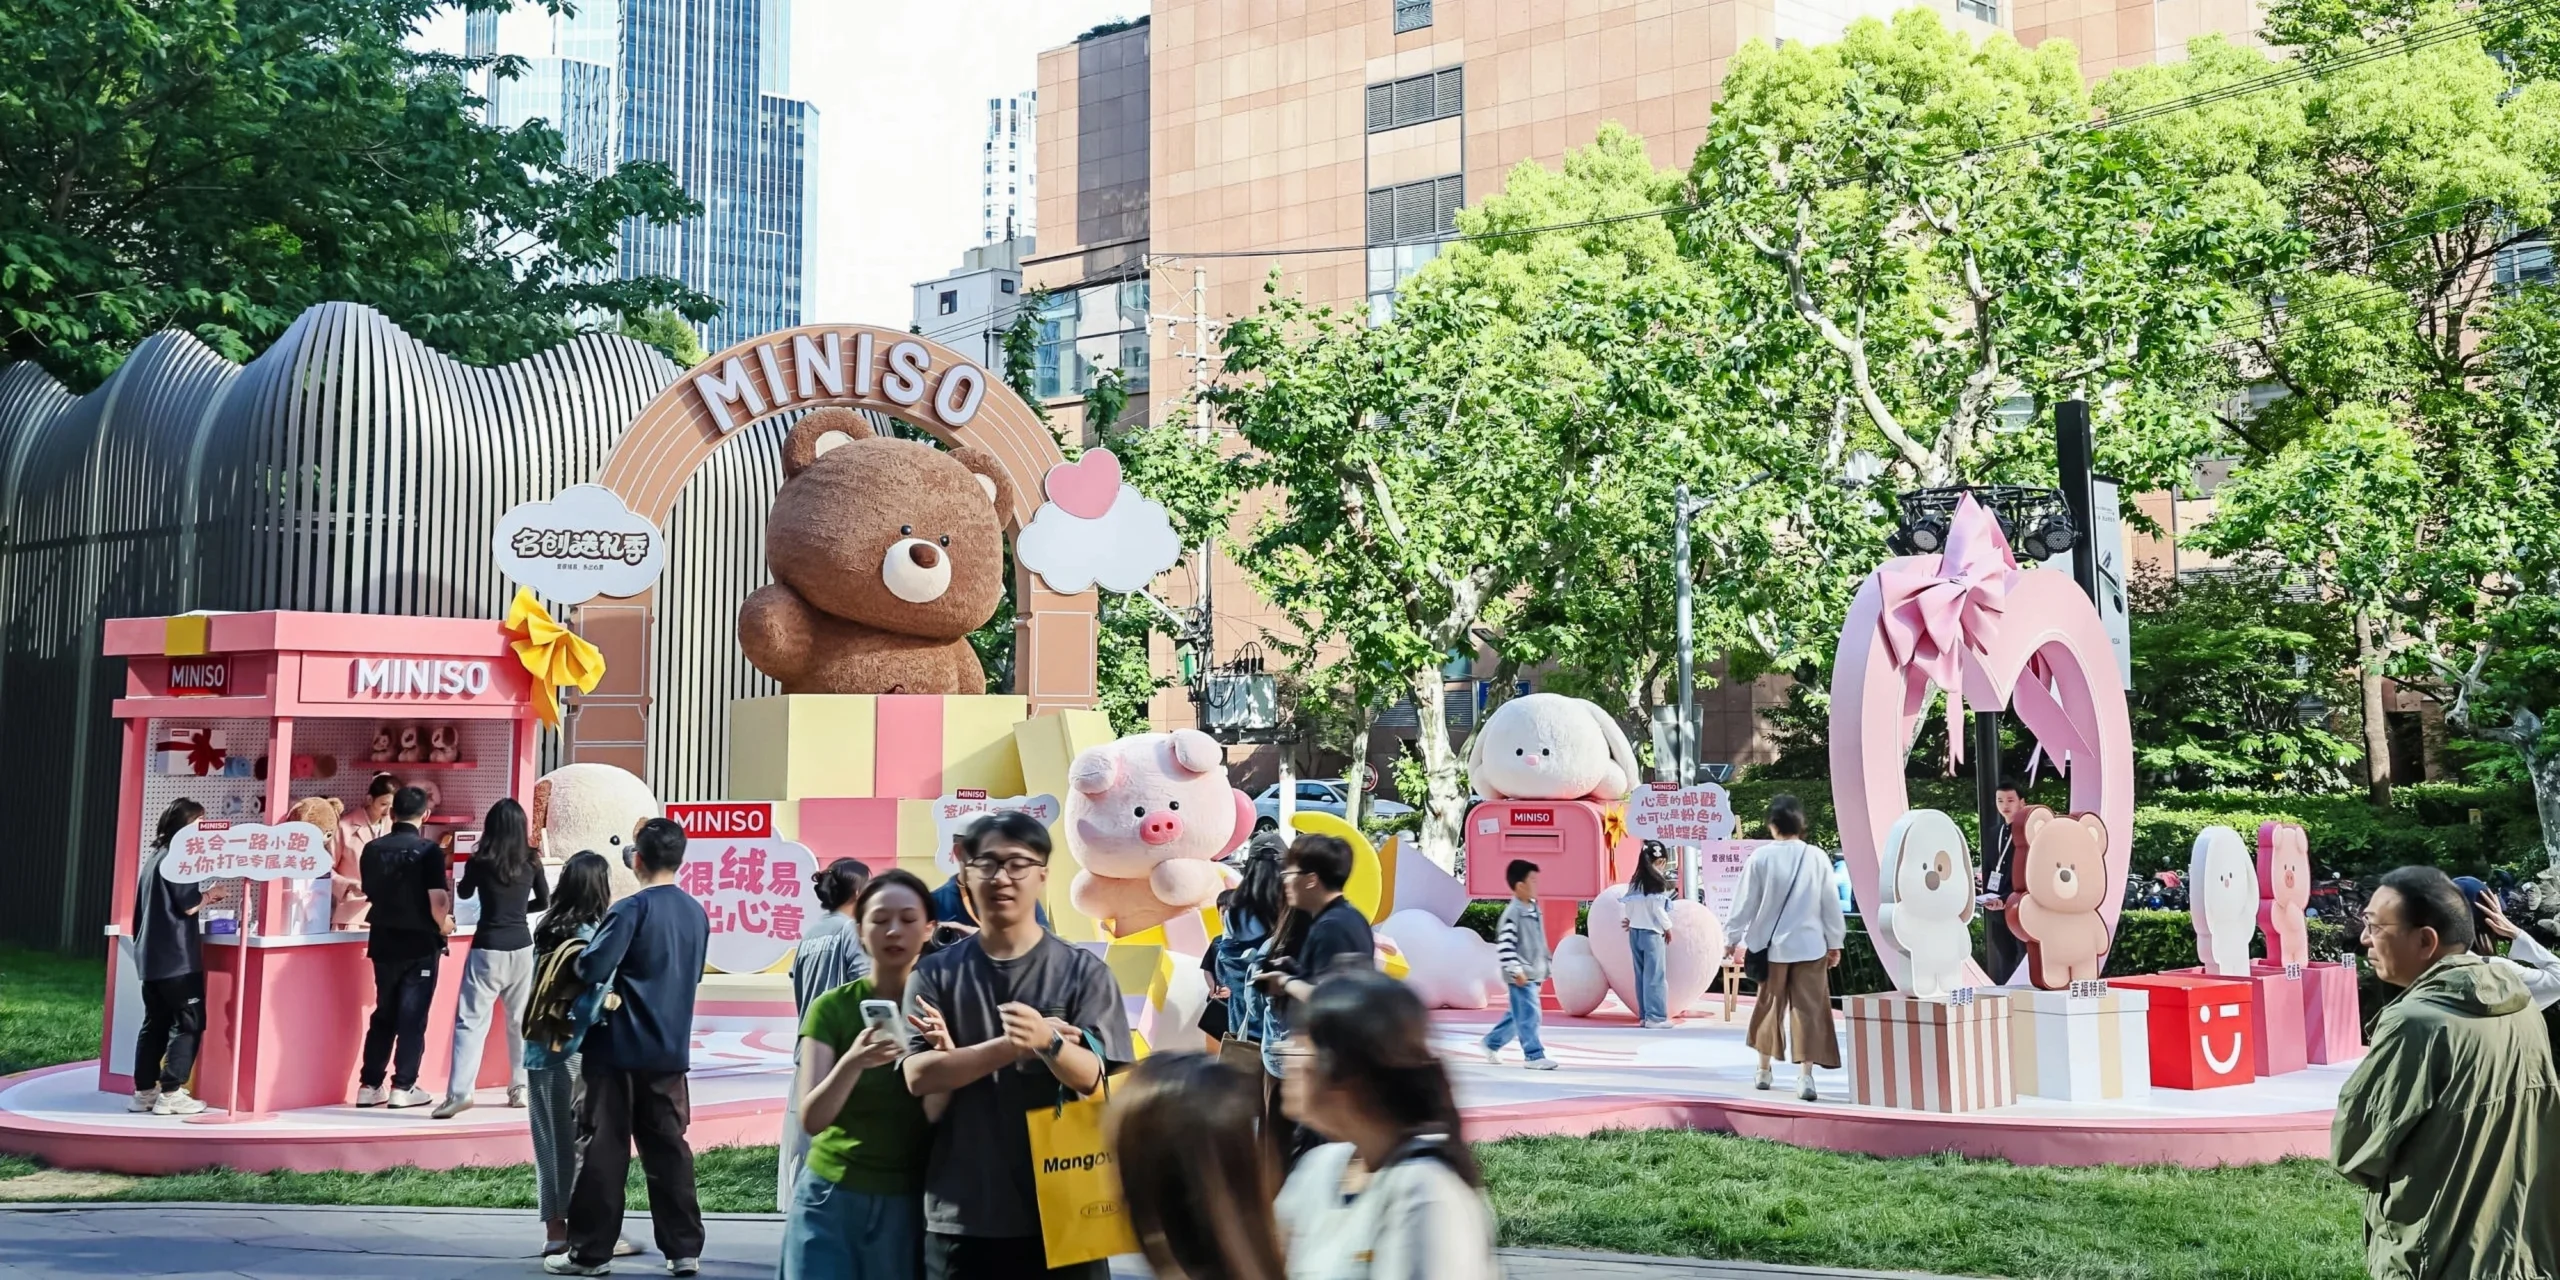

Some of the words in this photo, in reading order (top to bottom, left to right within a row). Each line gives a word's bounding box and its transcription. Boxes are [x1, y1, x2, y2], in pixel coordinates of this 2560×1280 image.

[692, 331, 987, 434] MINISO
[511, 527, 649, 565] 名创送礼季
[171, 664, 225, 688] MINISO
[354, 658, 489, 695] MINISO
[958, 790, 985, 798] MINISO
[1641, 792, 1716, 807] 心意的邮戳
[673, 810, 764, 832] MINISO
[1514, 813, 1550, 822] MINISO
[1636, 808, 1722, 825] 也可以是粉色的
[1657, 824, 1708, 840] 蝴蝶结
[185, 832, 309, 855] 我会一路小跑
[178, 854, 317, 876] 为你打包专属美好
[679, 846, 800, 898] 很绒易
[2071, 981, 2107, 998] 吉福特熊
